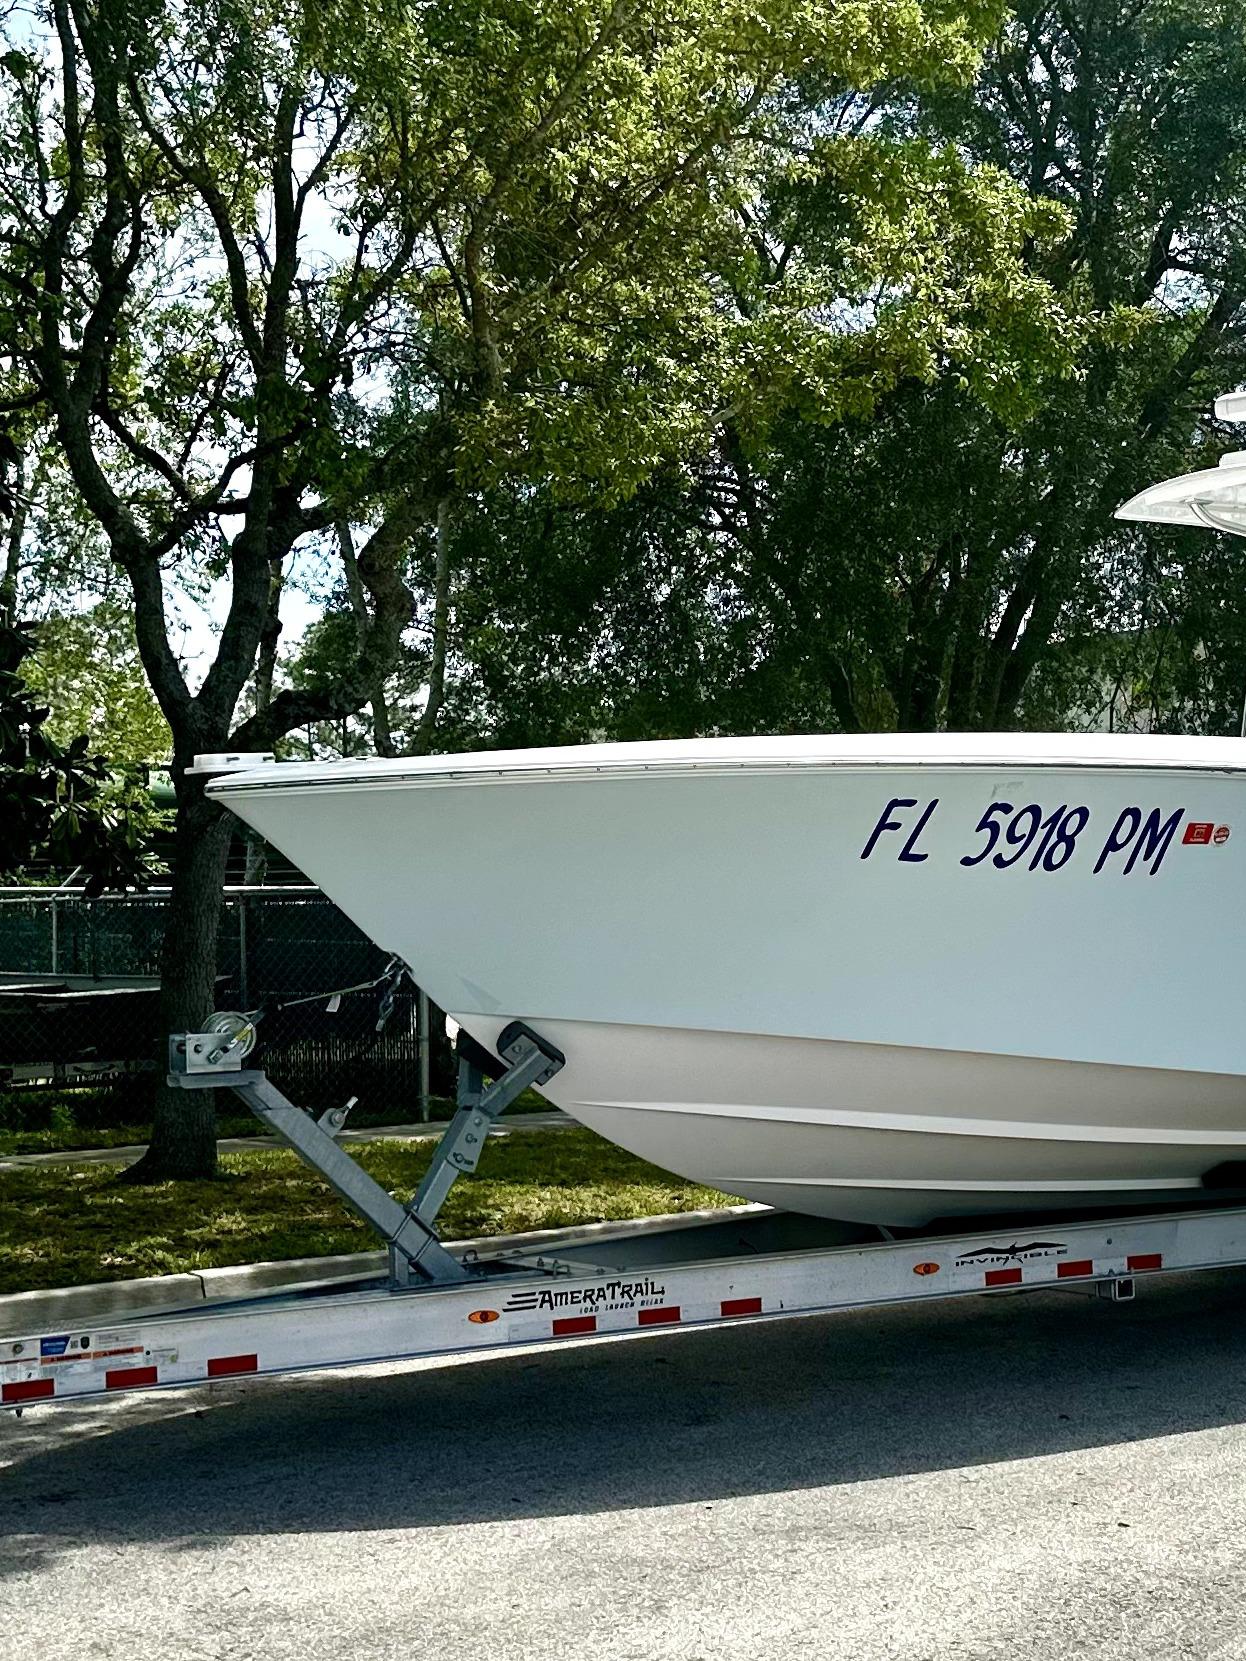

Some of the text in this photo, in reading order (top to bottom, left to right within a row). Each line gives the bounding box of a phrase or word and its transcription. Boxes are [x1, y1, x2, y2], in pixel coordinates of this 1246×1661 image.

[860, 798, 1186, 876] FL 5918 PM
